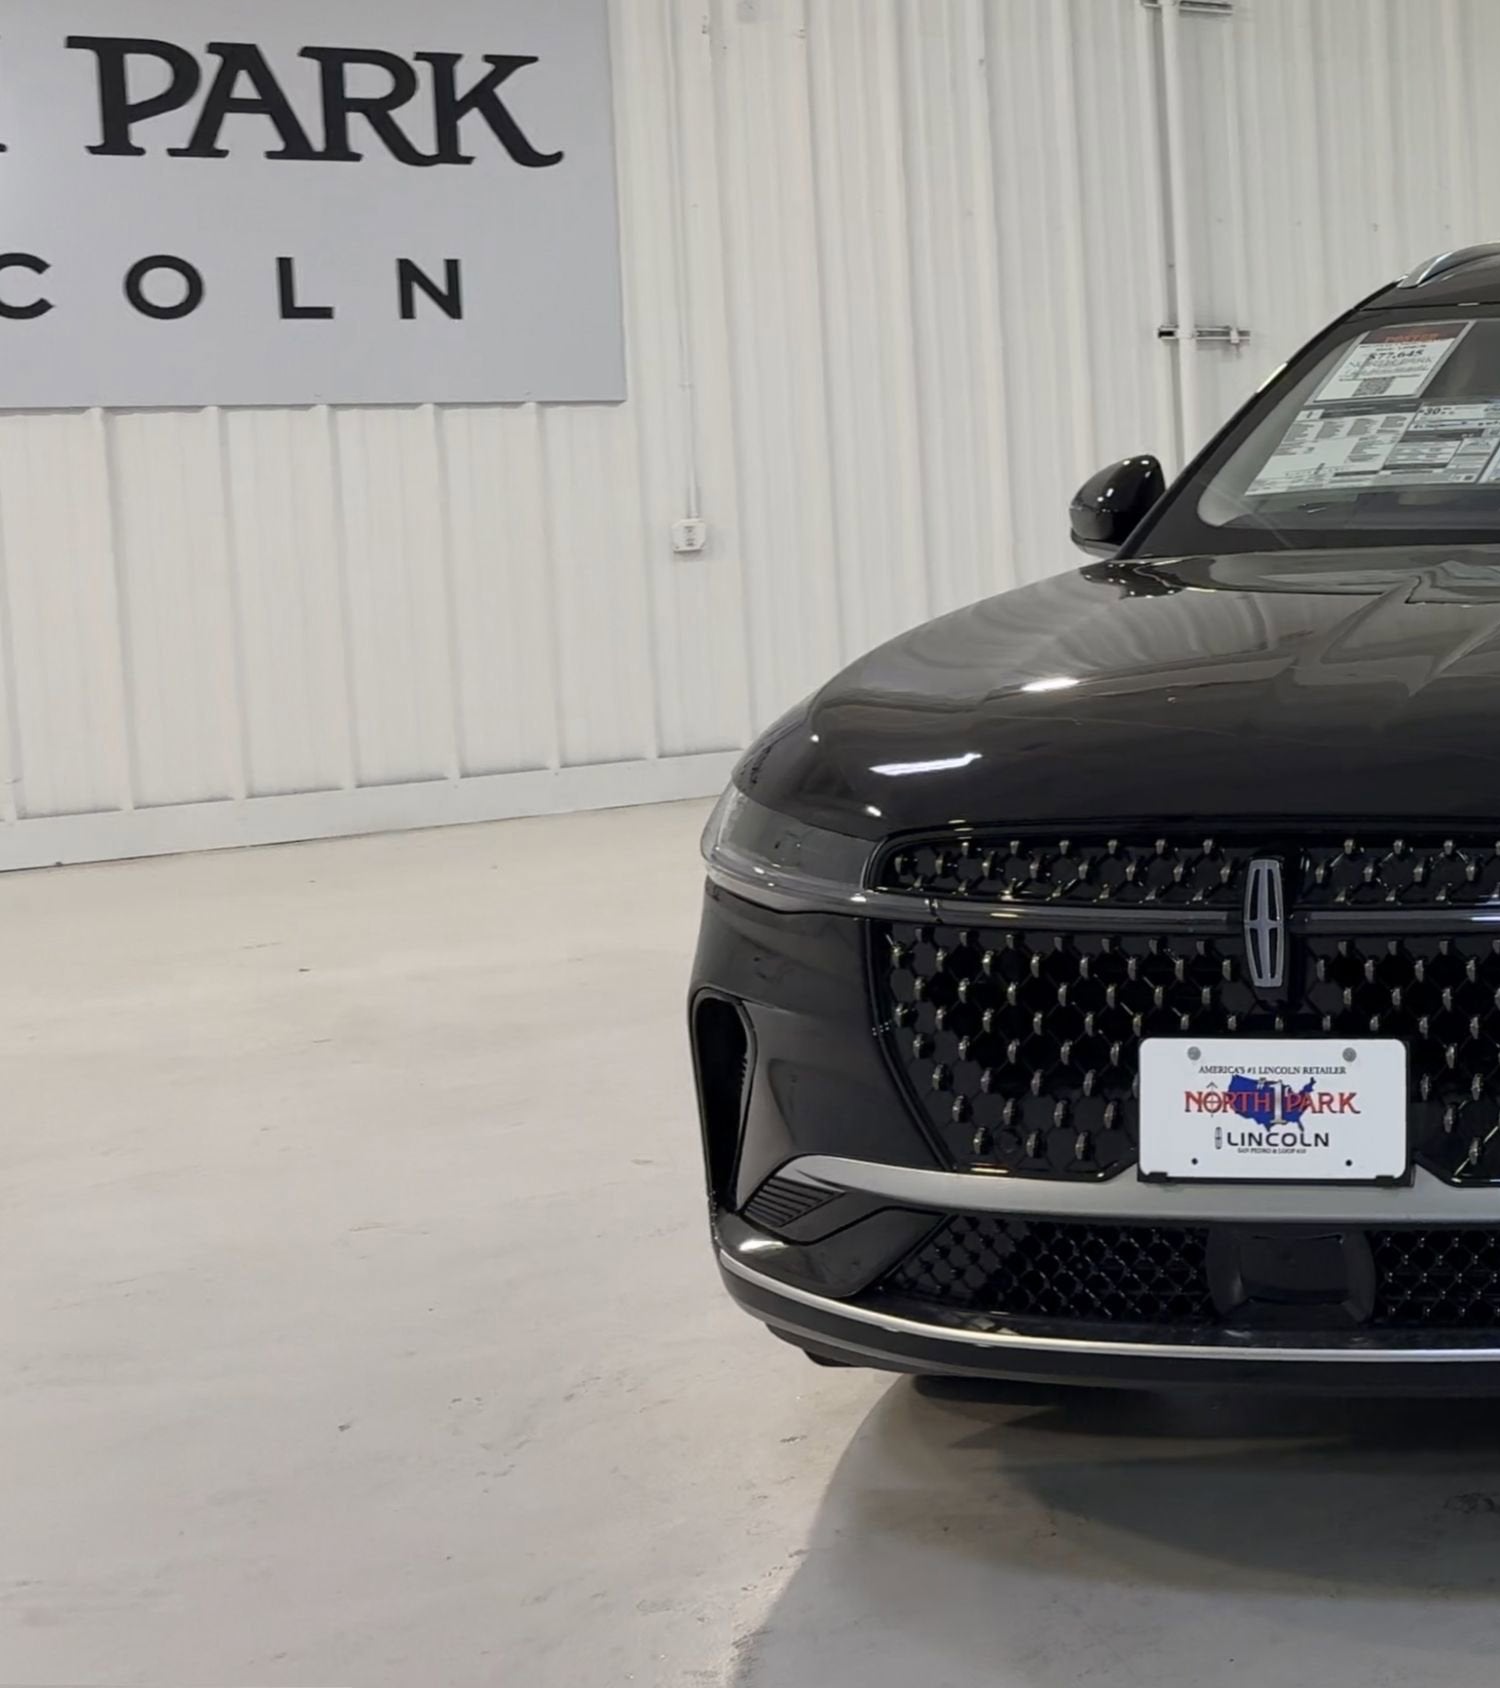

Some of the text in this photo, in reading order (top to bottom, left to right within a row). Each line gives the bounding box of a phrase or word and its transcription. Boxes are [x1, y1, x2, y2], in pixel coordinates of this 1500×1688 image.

[65, 35, 564, 167] PARK
[0, 252, 463, 320] COLN
[1198, 1066, 1347, 1075] AMERICA'S #1 LINCOLN RETAILER
[1184, 1091, 1361, 1114] NORTH PARK
[1227, 1132, 1329, 1147] LINCOLN
